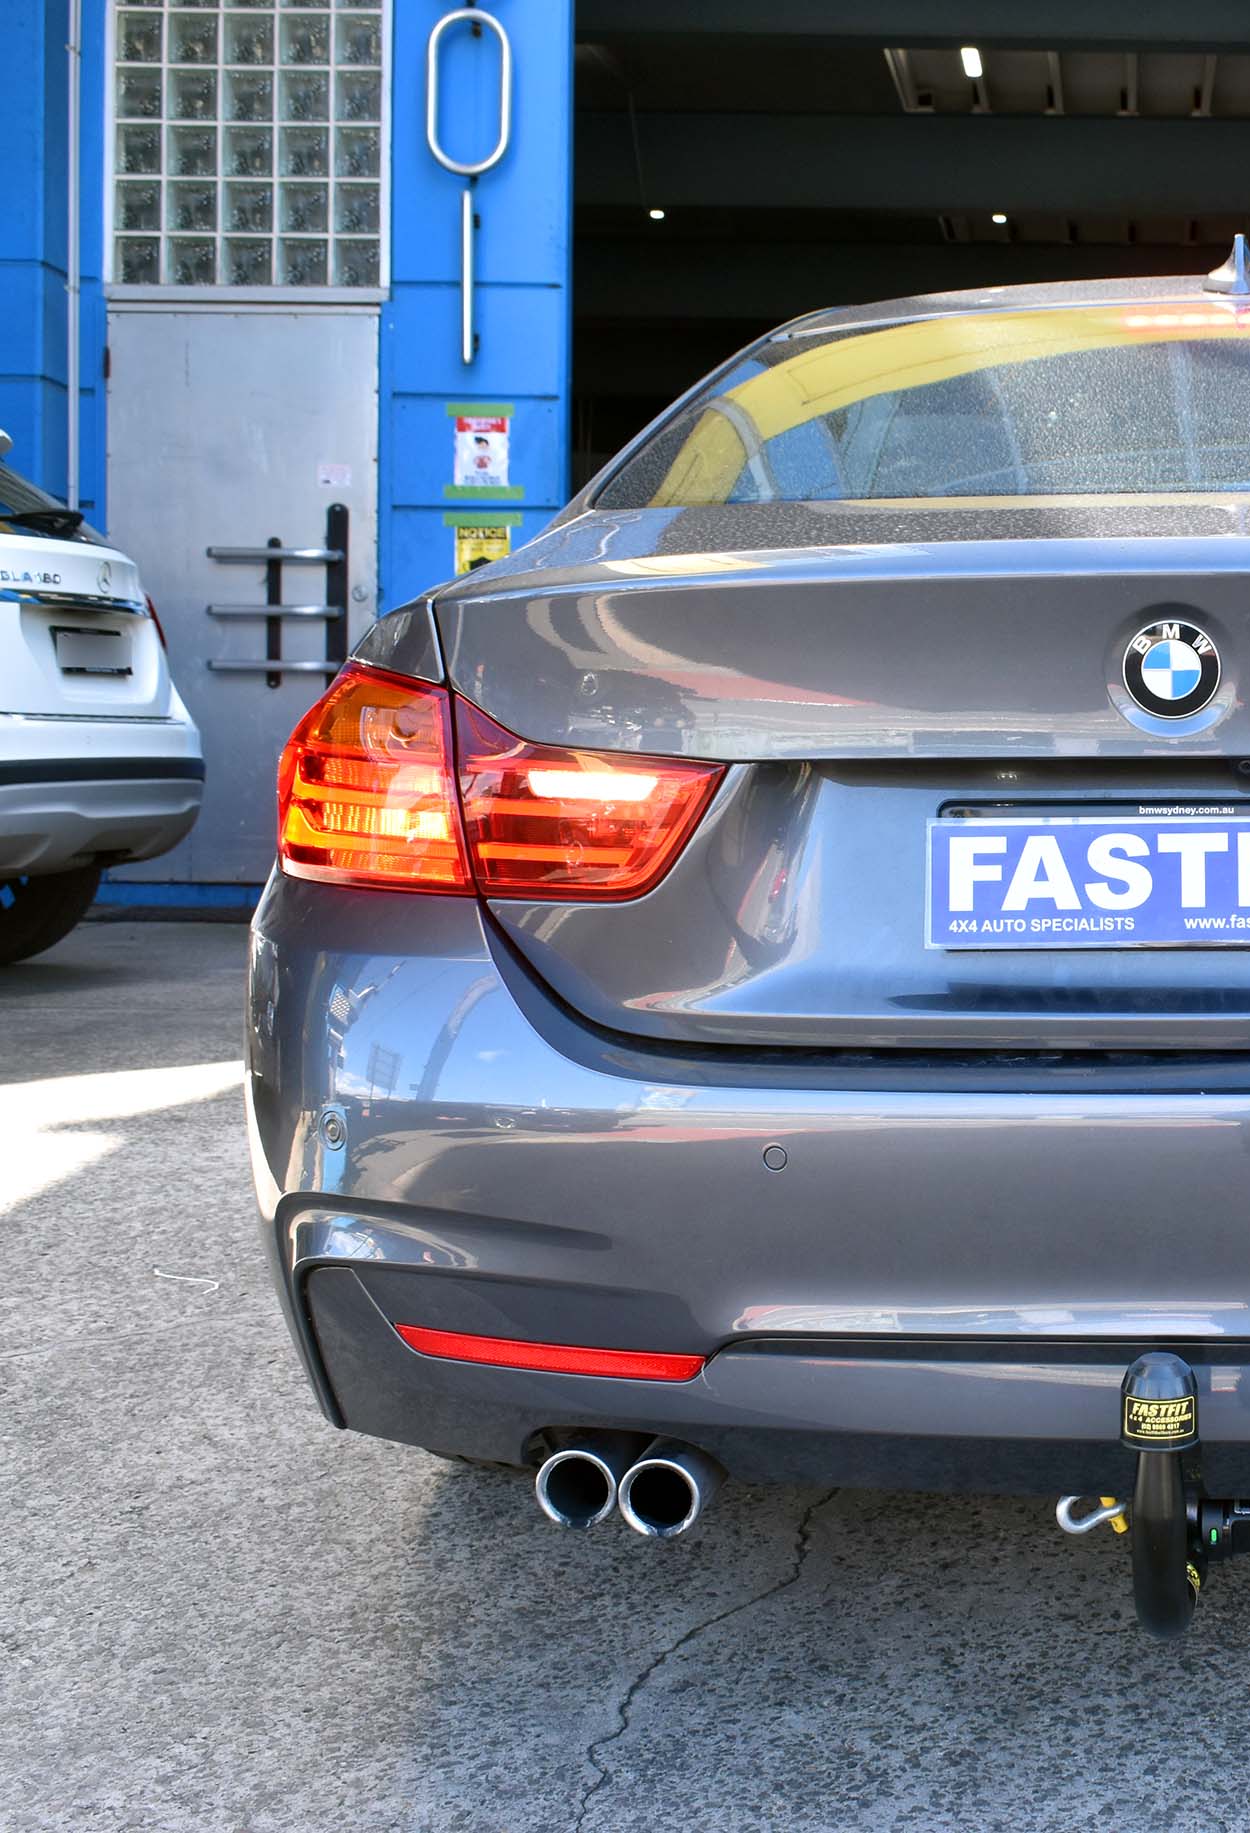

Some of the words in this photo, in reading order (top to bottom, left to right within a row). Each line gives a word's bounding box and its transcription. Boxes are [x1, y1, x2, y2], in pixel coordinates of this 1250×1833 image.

[1132, 623, 1212, 655] BMW
[1138, 805, 1235, 816] bmwsydney.com.au
[949, 919, 978, 933] 4X4
[981, 919, 1027, 933] AUTO
[1030, 917, 1135, 932] SPECIALISTS
[1132, 1401, 1189, 1417] FASTFIT
